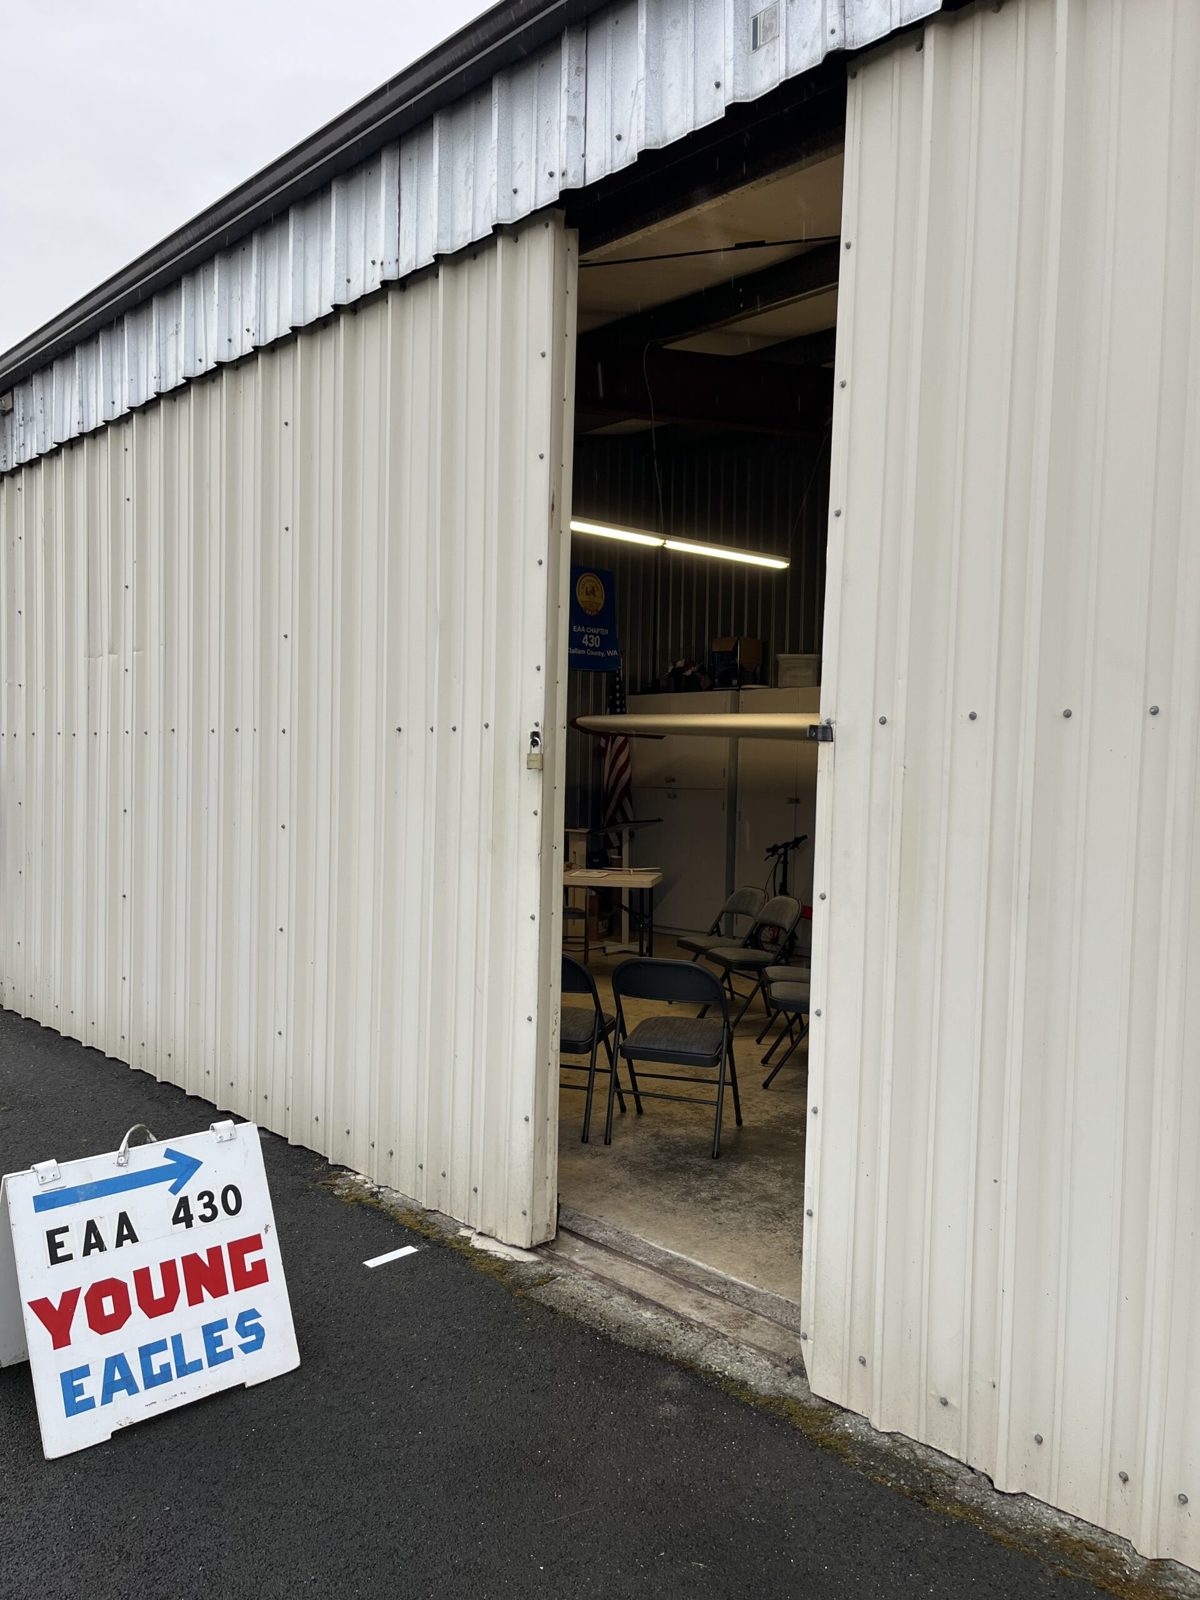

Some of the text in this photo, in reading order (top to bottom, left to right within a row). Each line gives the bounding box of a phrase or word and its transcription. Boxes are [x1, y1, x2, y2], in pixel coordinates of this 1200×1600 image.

[573, 625, 609, 635] EAA CHAPTER
[582, 634, 601, 648] 430
[46, 1184, 243, 1266] EAA 430
[27, 1233, 269, 1350] YOUNG
[59, 1307, 266, 1418] EAGLES
